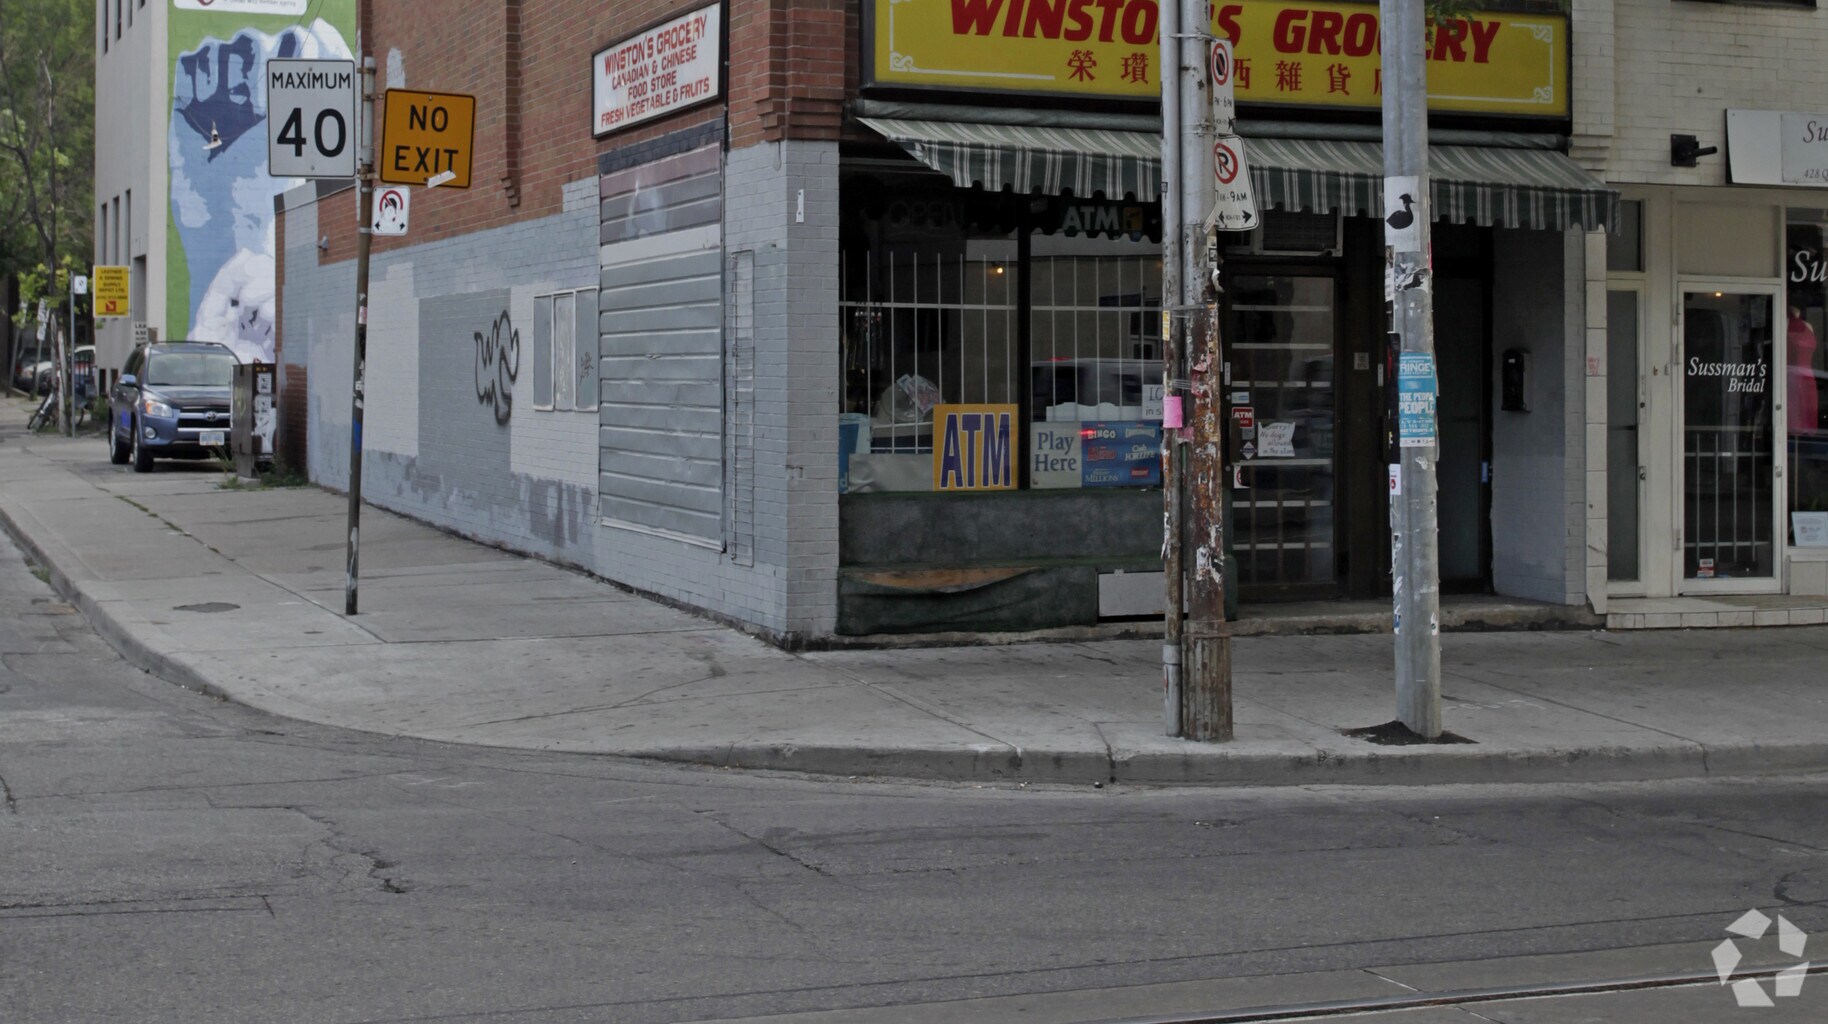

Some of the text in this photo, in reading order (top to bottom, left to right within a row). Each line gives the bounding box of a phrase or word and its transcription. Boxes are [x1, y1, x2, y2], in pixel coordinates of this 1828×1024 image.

[604, 14, 708, 76] WINSTON'S GROCERY
[1273, 8, 1501, 64] GRORY
[612, 44, 697, 90] CANADIAN & CHINESE
[271, 72, 351, 90] MAXIMUM
[628, 70, 677, 101] FOOD STORE
[601, 77, 710, 127] FRESH VEGETABLE & FRUITS
[409, 104, 449, 133] NO
[276, 107, 347, 158] 40
[394, 145, 459, 174] EXIT
[1062, 206, 1120, 231] ATM
[1399, 362, 1431, 373] RINGE
[1688, 356, 1767, 378] Sussman's
[1728, 378, 1766, 393] Bridal
[1234, 411, 1253, 419] ATM
[1037, 431, 1075, 455] Play
[1087, 429, 1116, 439] BINGO
[940, 413, 1011, 488] ATM
[1034, 454, 1077, 472] Here
